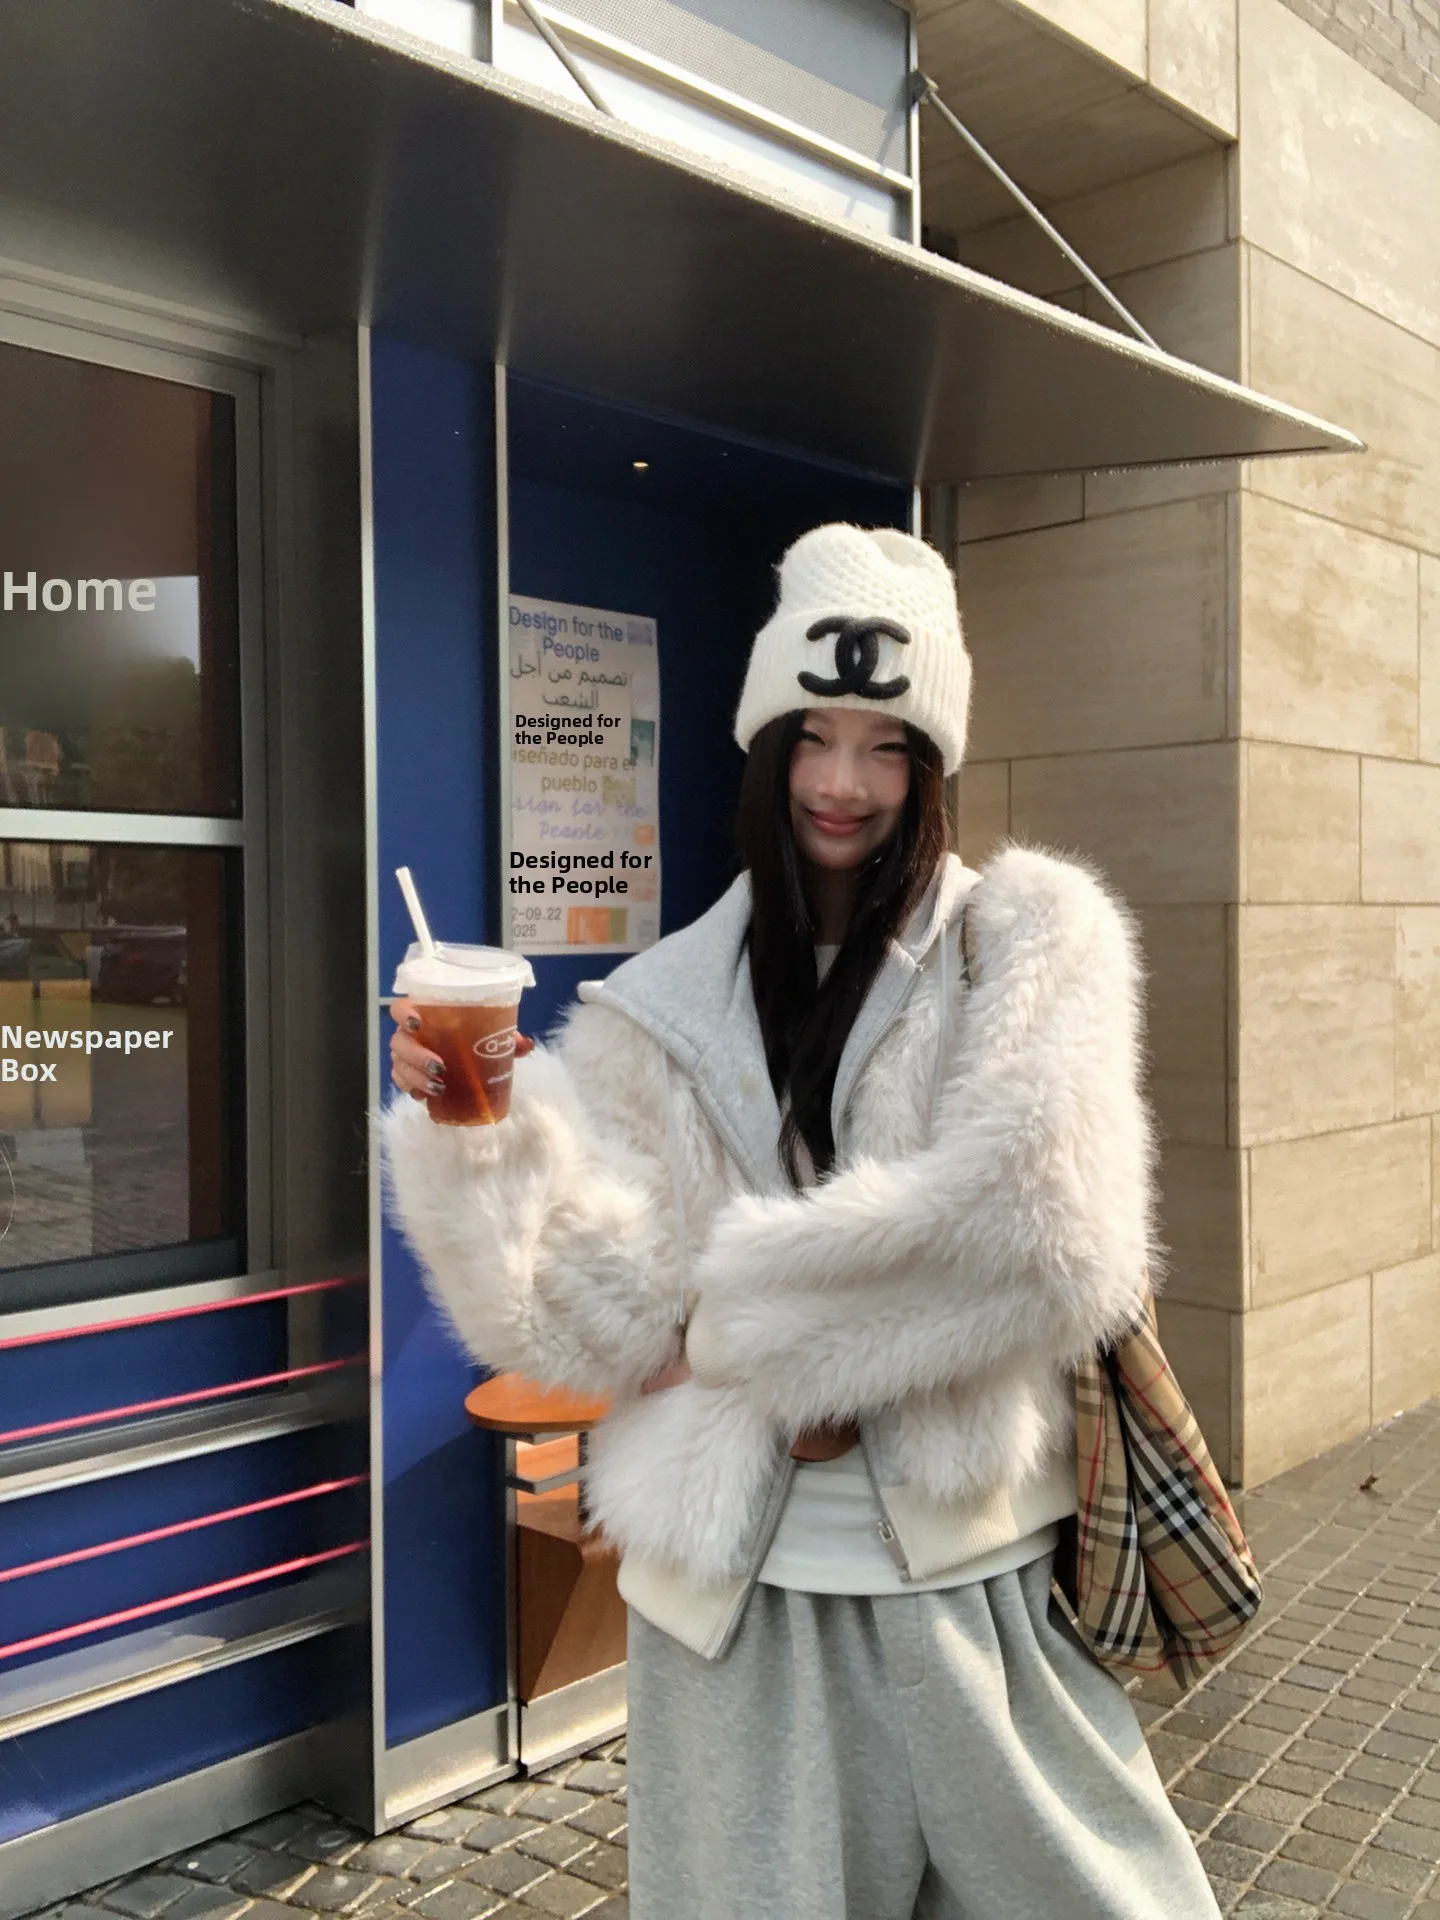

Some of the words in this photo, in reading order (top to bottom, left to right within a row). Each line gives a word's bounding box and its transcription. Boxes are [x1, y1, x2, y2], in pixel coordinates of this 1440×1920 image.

[508, 605, 569, 636] Design
[572, 616, 597, 636] for
[598, 622, 624, 642] the
[542, 636, 601, 664] People
[583, 753, 618, 771] para
[541, 775, 598, 794] pueblo
[512, 924, 537, 938] 025
